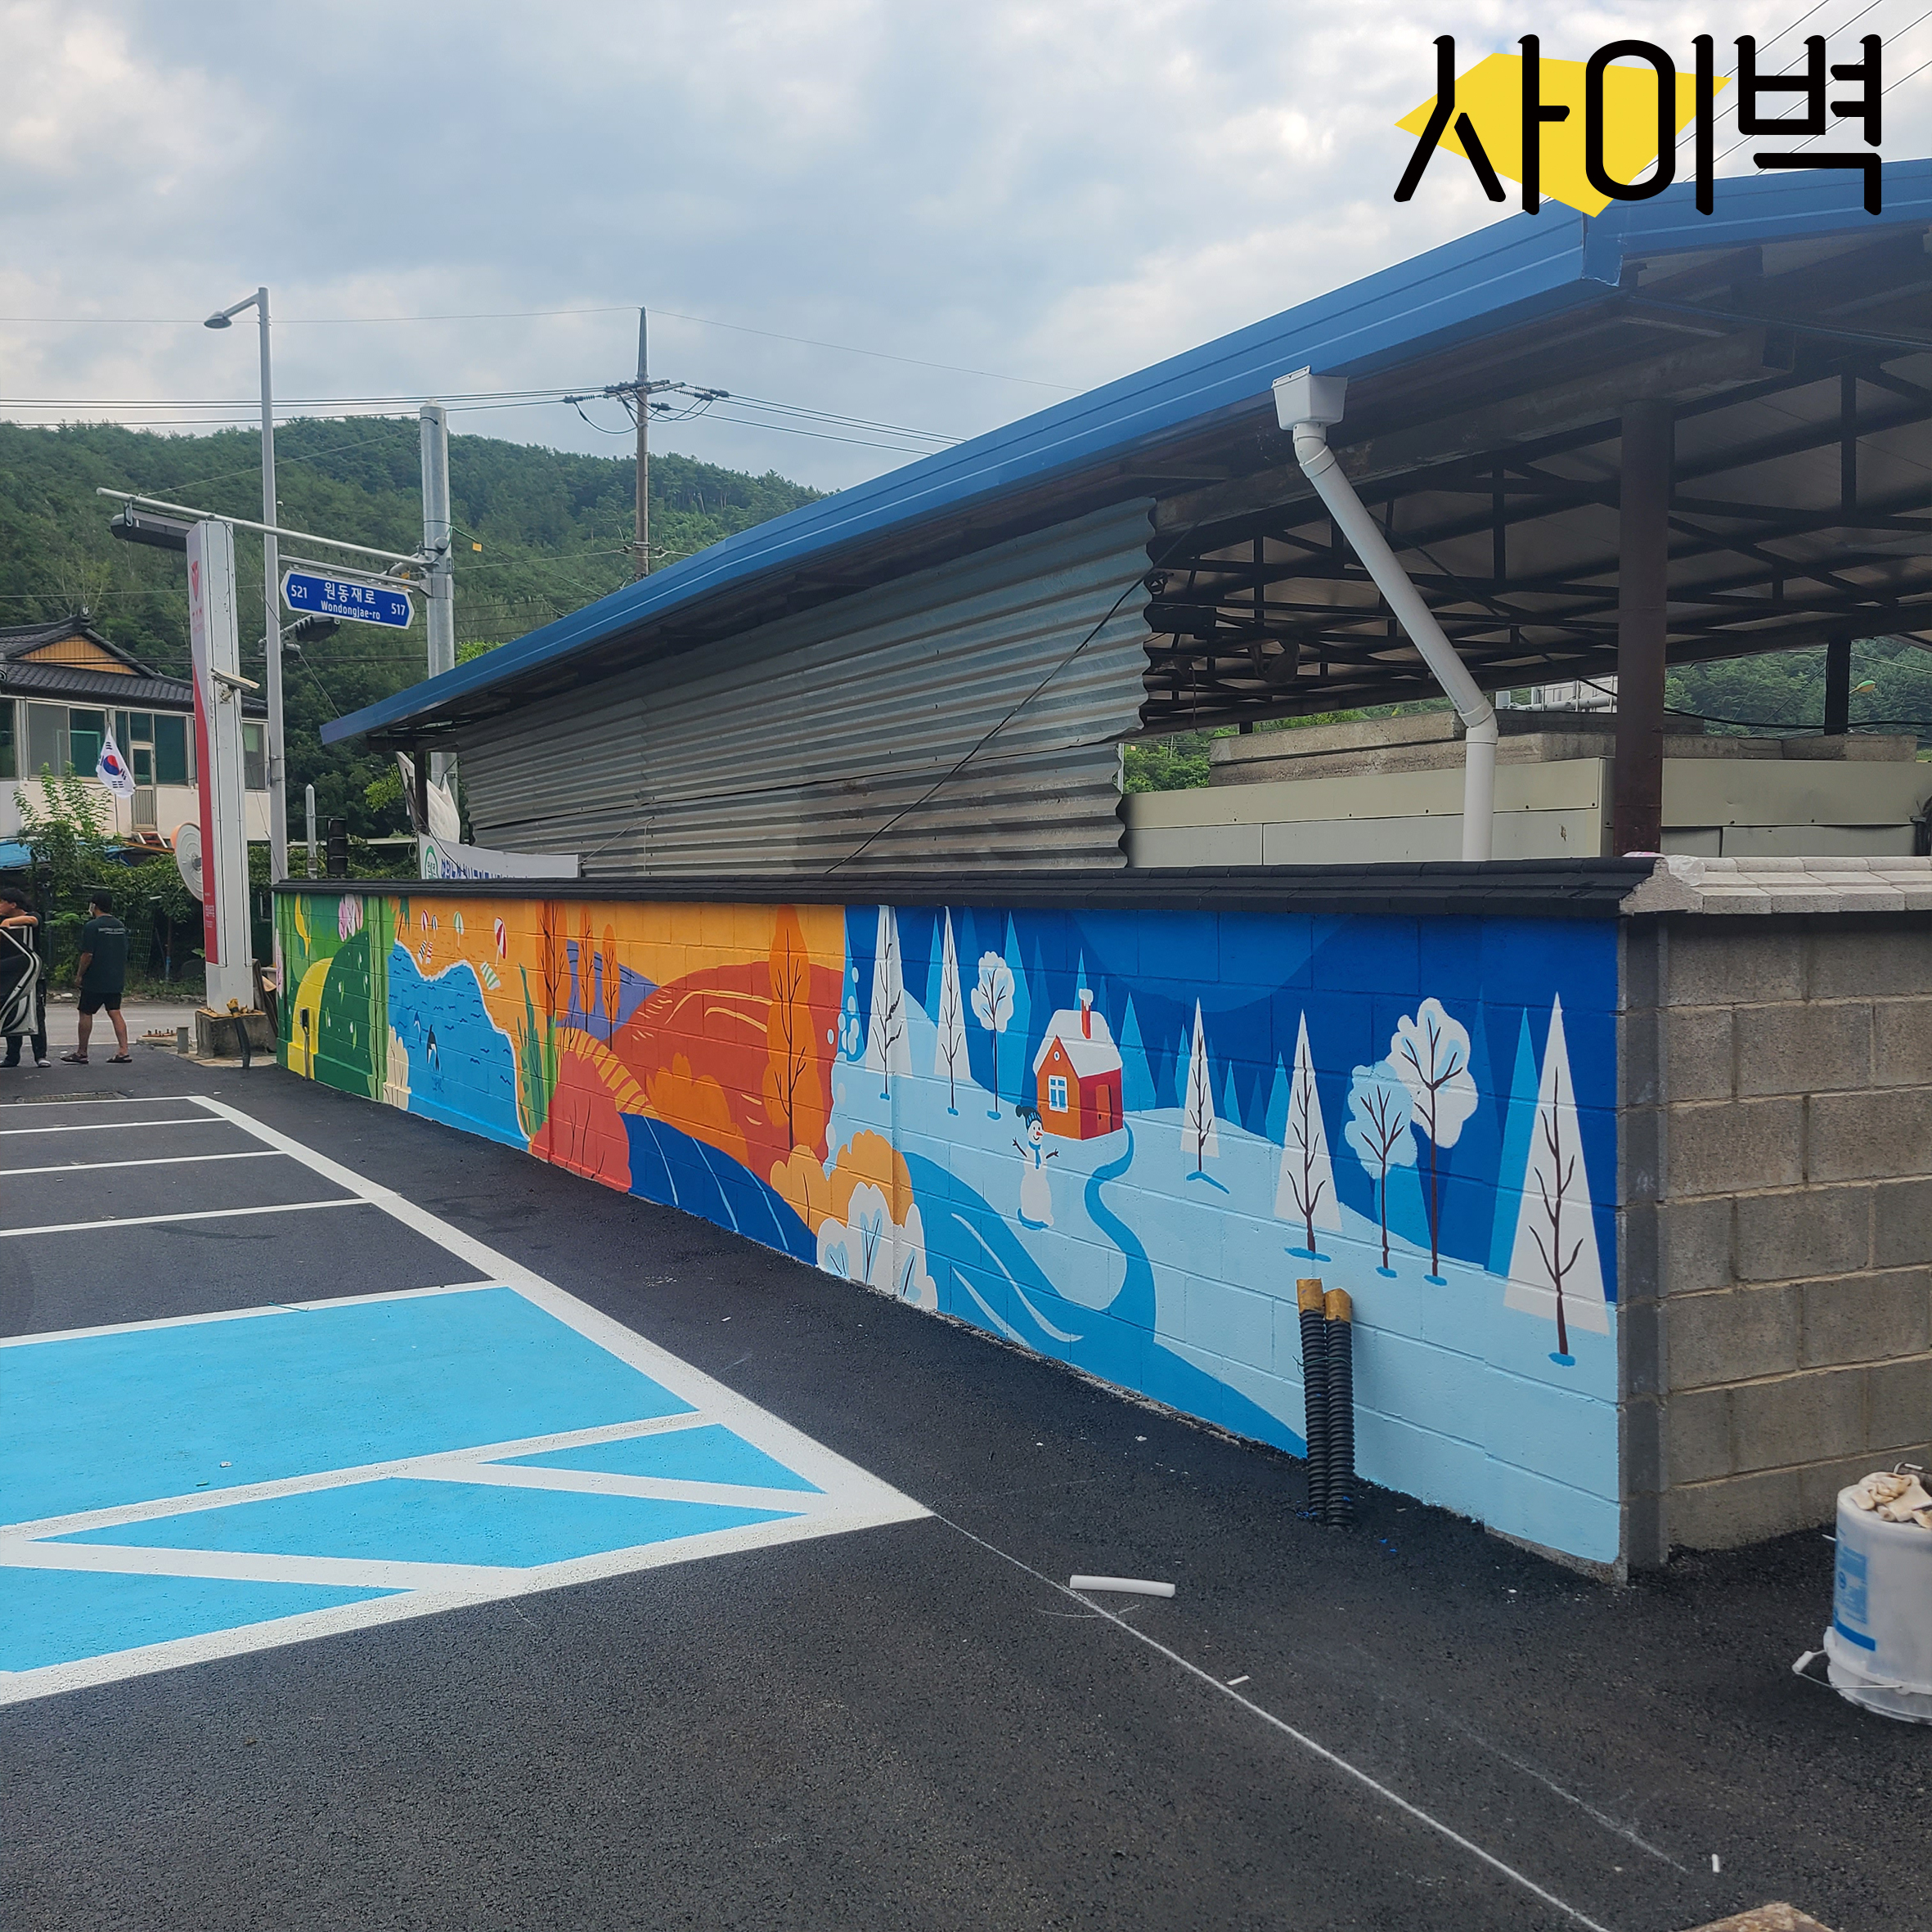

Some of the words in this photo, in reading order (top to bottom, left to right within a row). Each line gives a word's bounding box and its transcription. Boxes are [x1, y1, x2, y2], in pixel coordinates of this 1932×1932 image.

[290, 584, 308, 599] 521
[324, 582, 376, 604] 원동재로
[321, 600, 380, 620] Wondongjae-ro
[391, 603, 406, 616] 517
